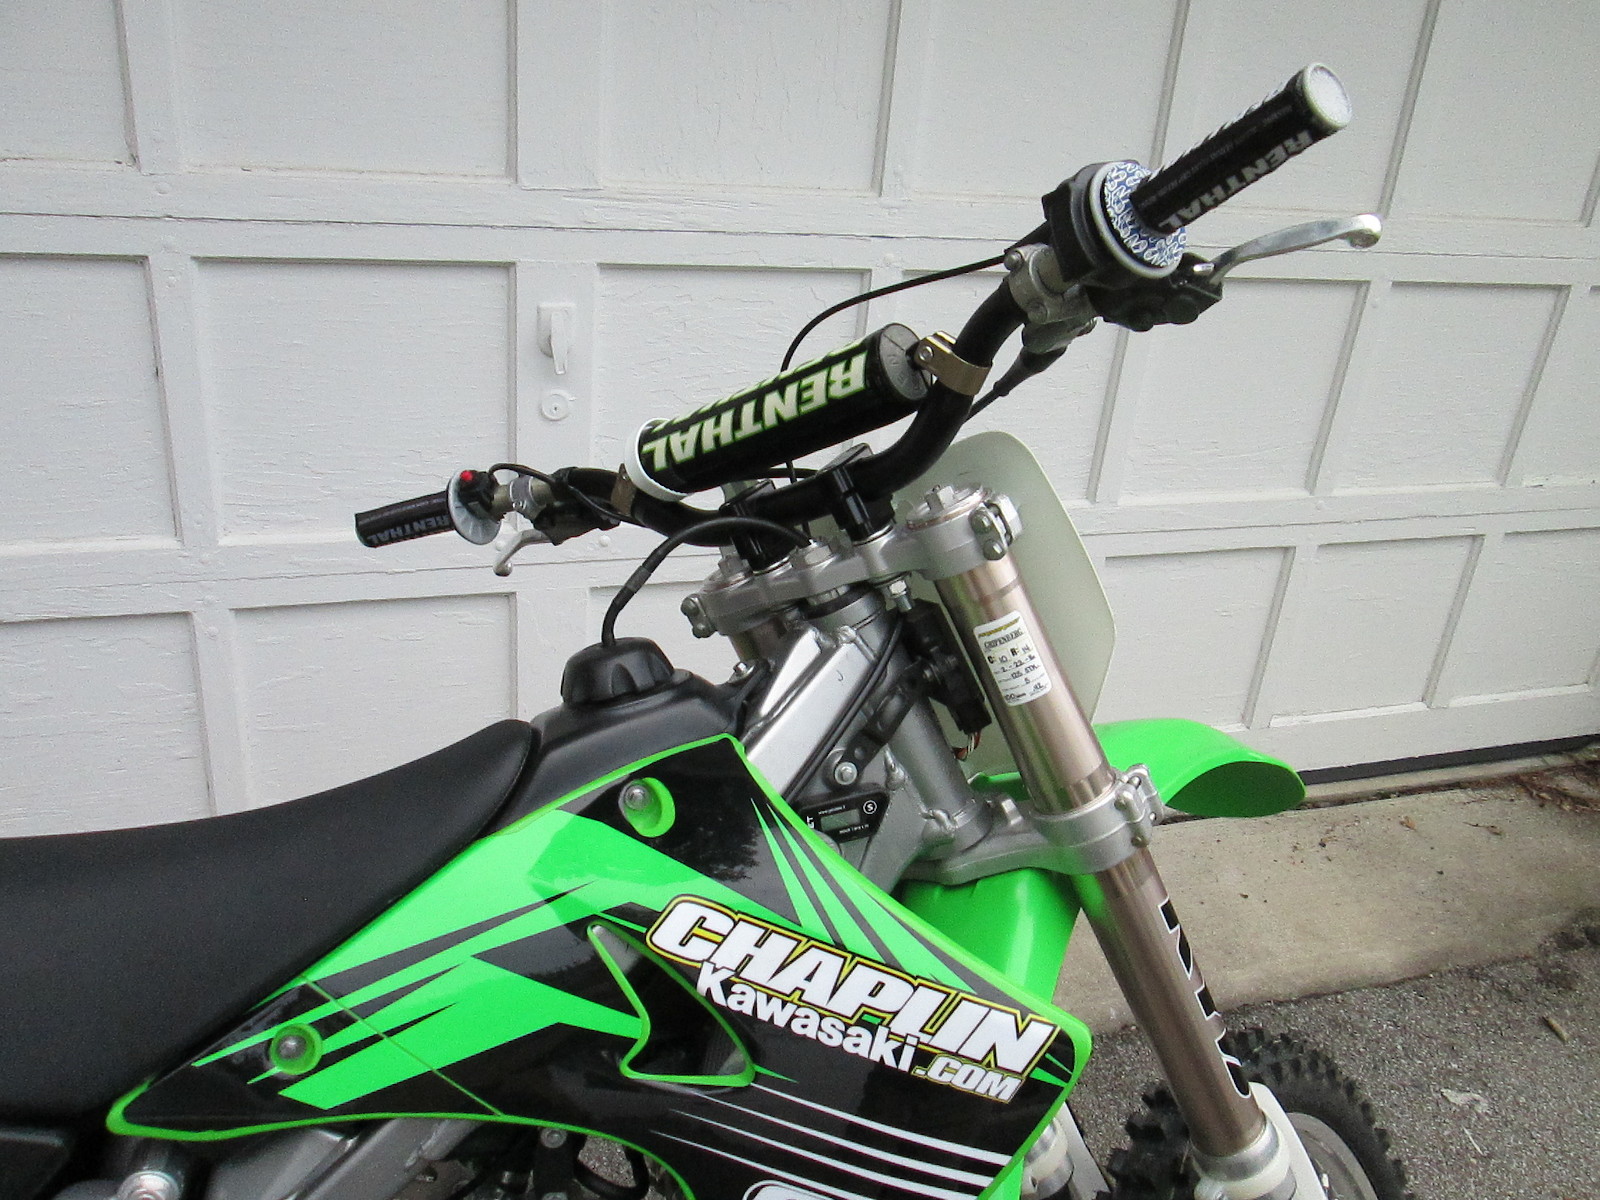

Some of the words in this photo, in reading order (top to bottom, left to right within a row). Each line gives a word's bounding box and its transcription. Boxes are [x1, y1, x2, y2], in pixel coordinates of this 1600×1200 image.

[1158, 130, 1314, 230] RENTHAL
[641, 350, 869, 473] RENTHAL
[367, 513, 451, 545] RENTHAL
[646, 896, 1060, 1073] CHAPLIN
[695, 961, 919, 1073] Kawasaki
